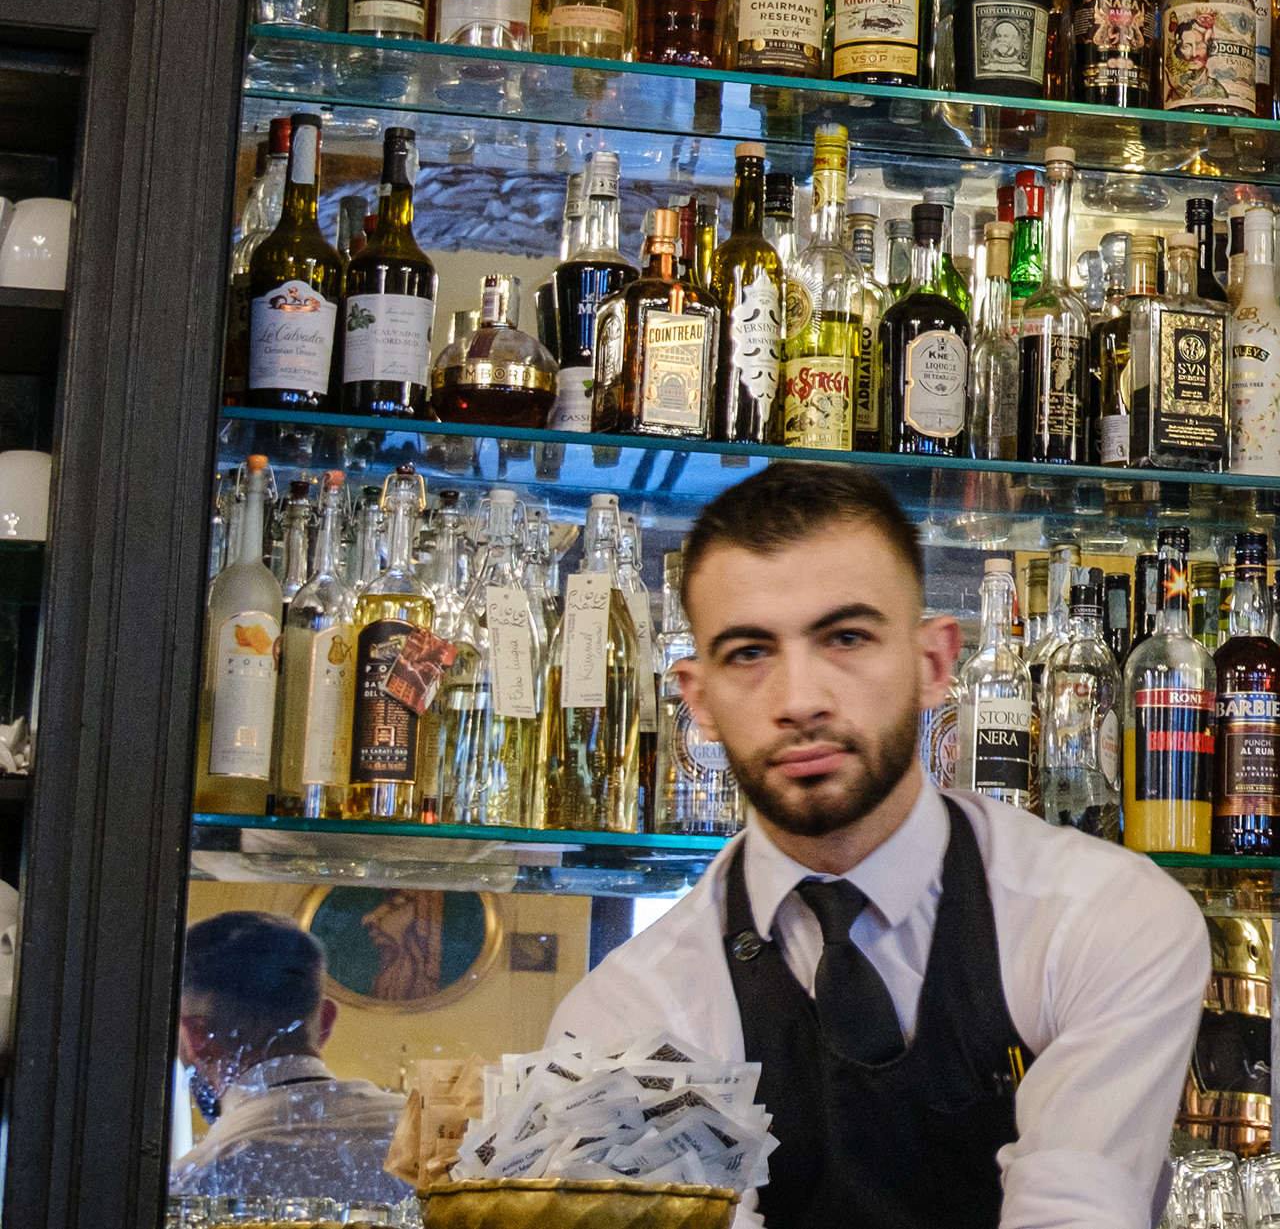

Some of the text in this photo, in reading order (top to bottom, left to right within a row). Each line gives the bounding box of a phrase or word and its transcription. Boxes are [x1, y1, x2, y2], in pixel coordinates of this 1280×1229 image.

[751, 1, 818, 18] CHAIRMAN'S
[1109, 9, 1133, 17] RUM
[760, 12, 811, 26] RESERVE
[773, 28, 800, 39] RUM
[1218, 43, 1237, 55] DON
[275, 323, 326, 345] Calvados
[648, 323, 704, 344] COINTREAU
[860, 326, 873, 412] ADRIATICO
[561, 414, 591, 422] CASSI
[978, 729, 1020, 747] NERA
[1244, 739, 1272, 748] PUNCH
[693, 746, 724, 760] GRAP
[1240, 747, 1275, 757] AL RUM
[565, 1097, 587, 1112] Antico
[501, 1157, 525, 1172] Antico
